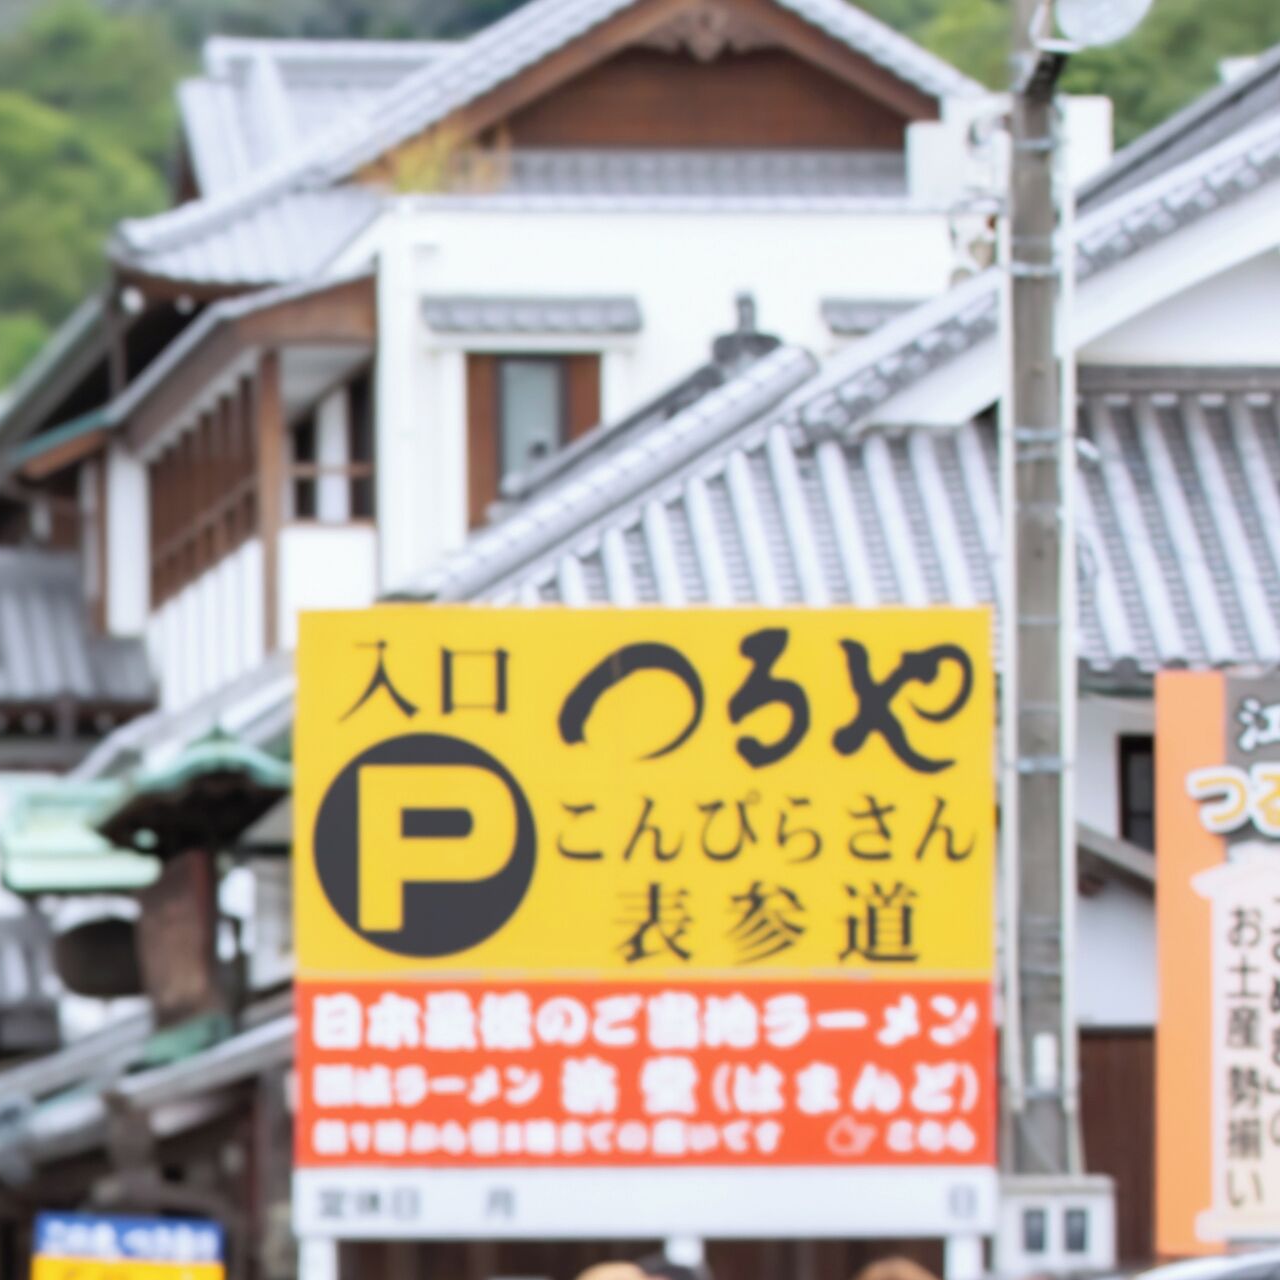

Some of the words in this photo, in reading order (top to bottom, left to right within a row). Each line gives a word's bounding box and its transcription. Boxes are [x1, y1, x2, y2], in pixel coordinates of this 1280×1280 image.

[339, 639, 510, 723] 入口
[557, 627, 974, 774] つるや
[357, 764, 518, 932] P
[556, 789, 977, 863] こんぴらさん
[614, 880, 920, 964] 表参道
